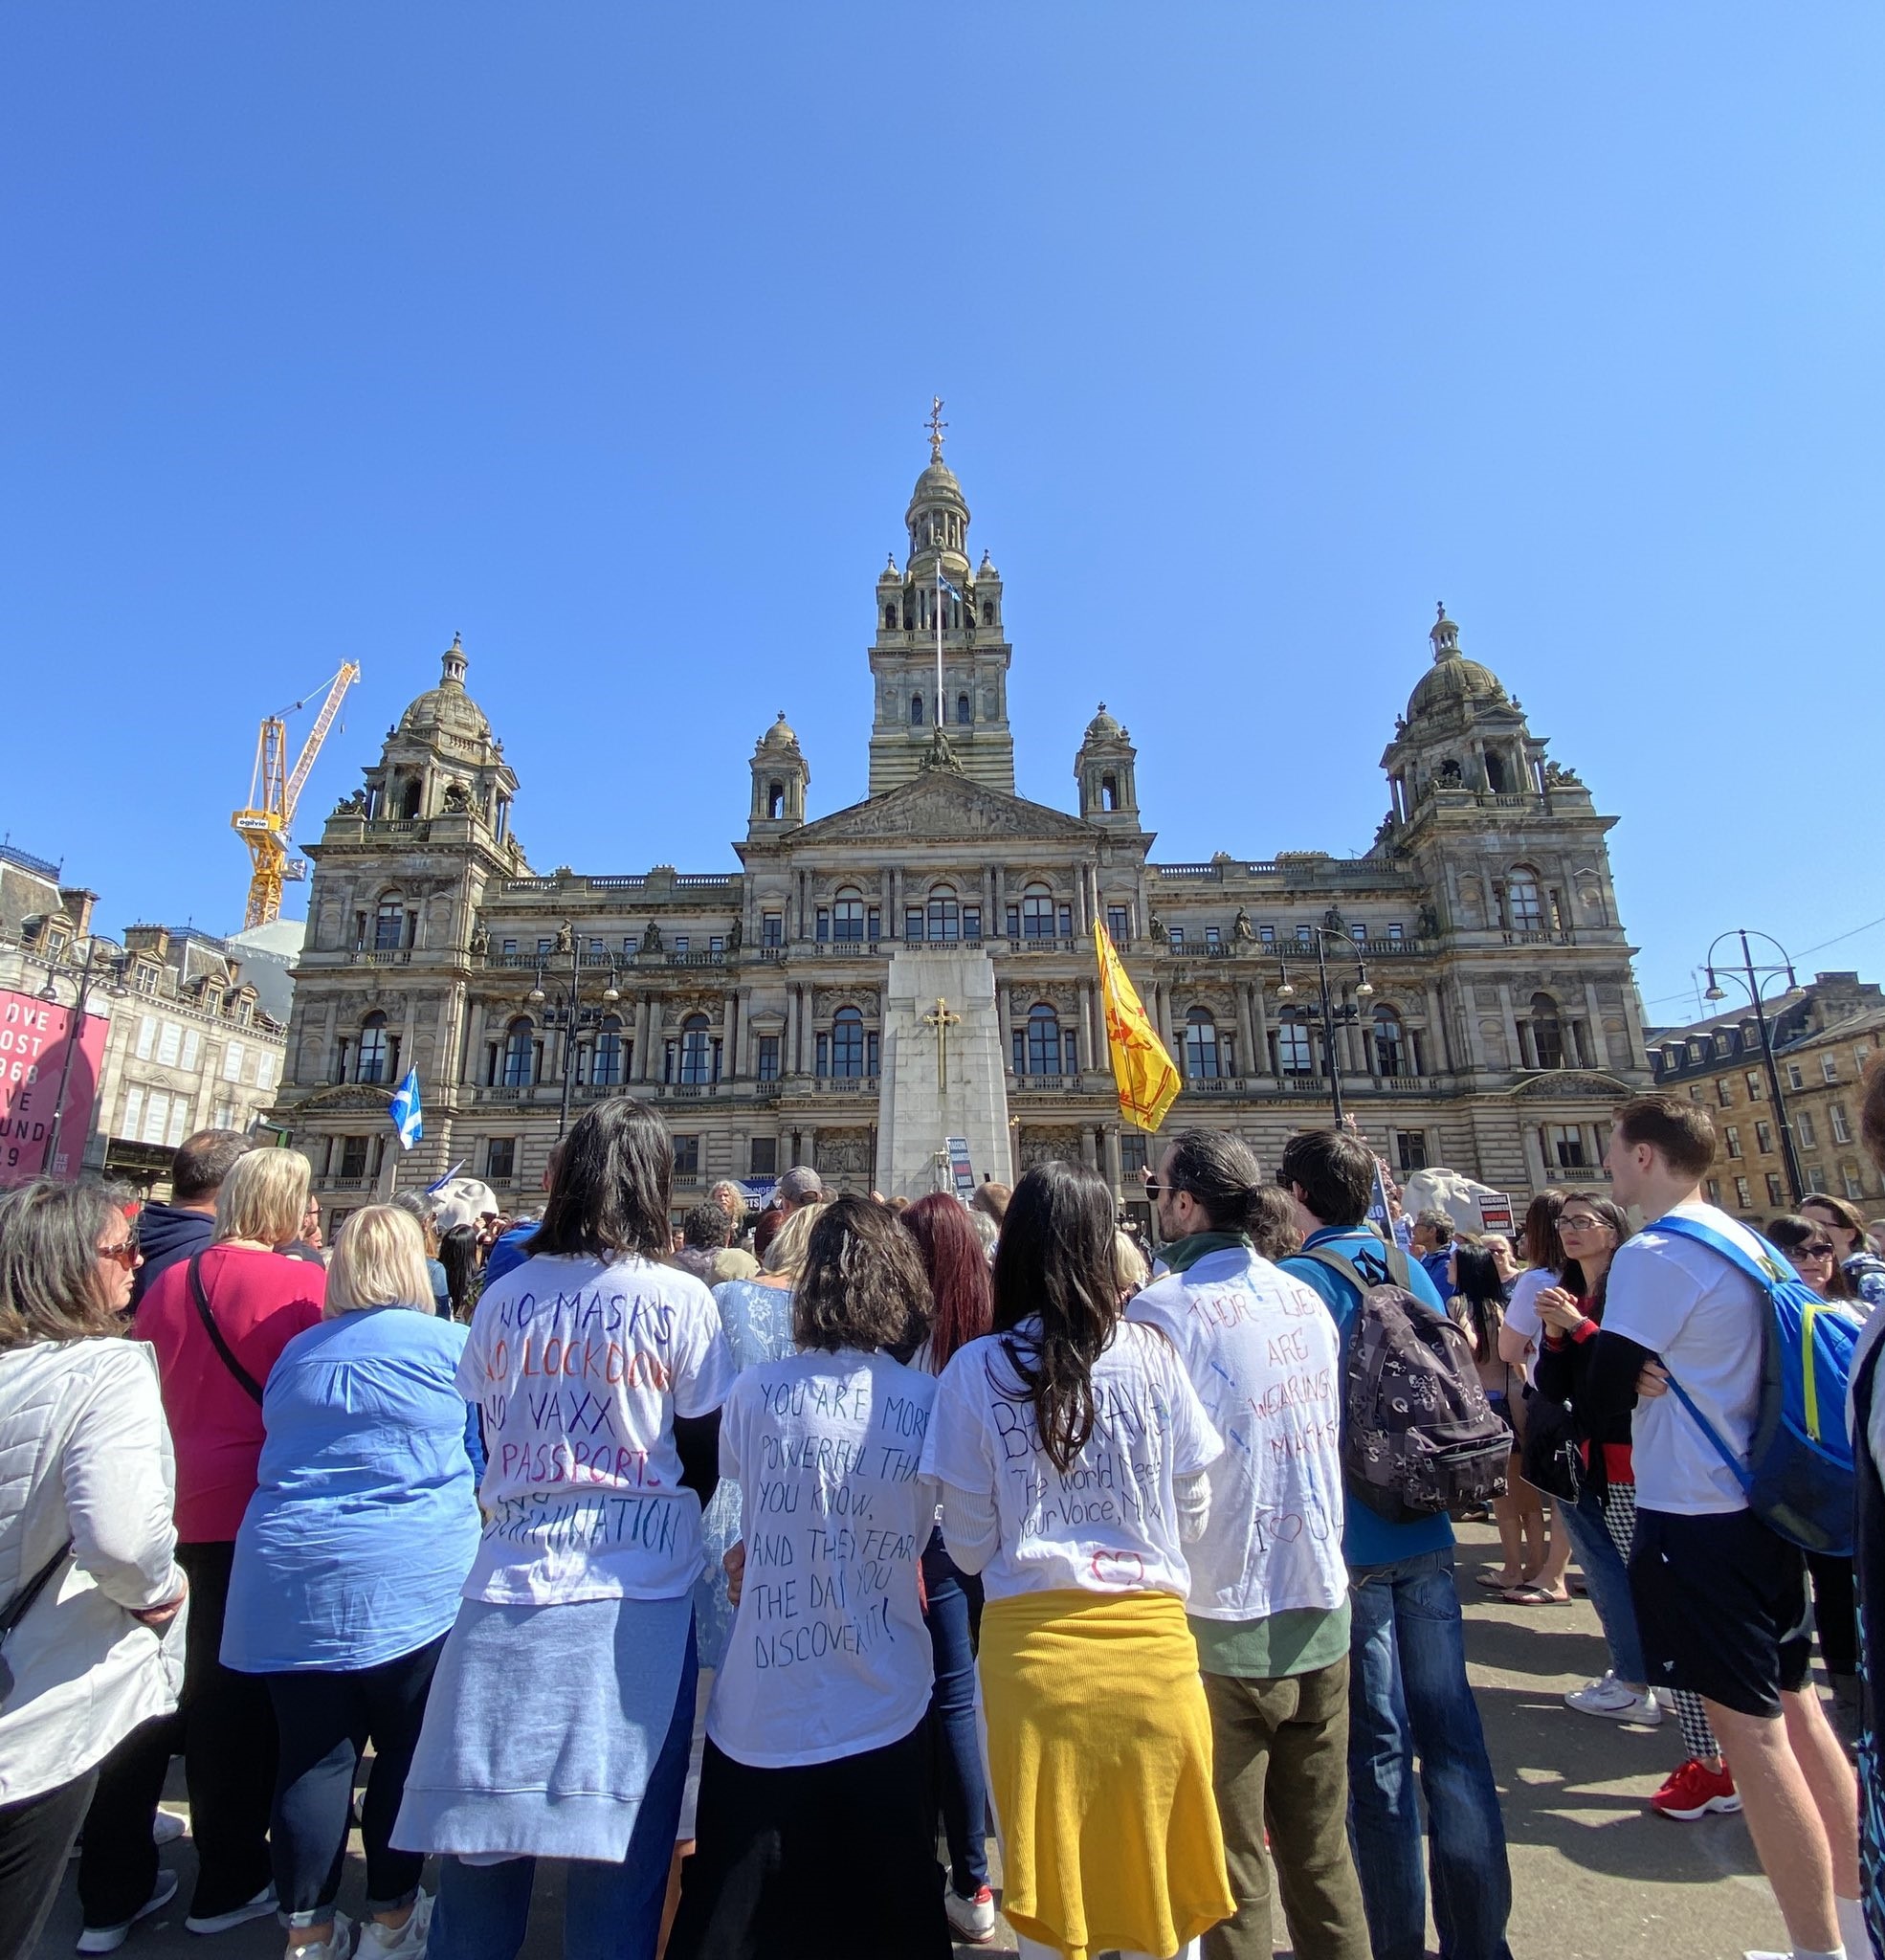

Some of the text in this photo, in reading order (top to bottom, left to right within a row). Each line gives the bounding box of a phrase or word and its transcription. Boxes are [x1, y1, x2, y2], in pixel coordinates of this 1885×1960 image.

[239, 819, 267, 828] ogilvie
[500, 1290, 676, 1345] NO MASKS
[1186, 1292, 1259, 1339] THEIR
[523, 1338, 673, 1394] LOCKDOW
[1267, 1327, 1308, 1368] ARE
[484, 1391, 617, 1437] NO VAXX
[761, 1384, 806, 1416] YOU
[815, 1385, 869, 1421] ARE
[1072, 1383, 1165, 1444] RAVE
[763, 1436, 920, 1486] POWERFUL THA
[1011, 1469, 1048, 1506] The
[1058, 1453, 1114, 1494] World
[759, 1483, 798, 1514] YOU
[1018, 1507, 1057, 1543] Your
[1058, 1496, 1122, 1526] Voice,
[750, 1528, 916, 1567] AND THEY FEAR
[751, 1580, 798, 1620] THE
[856, 1560, 893, 1597] YOU
[755, 1619, 868, 1668] DISCOVER
